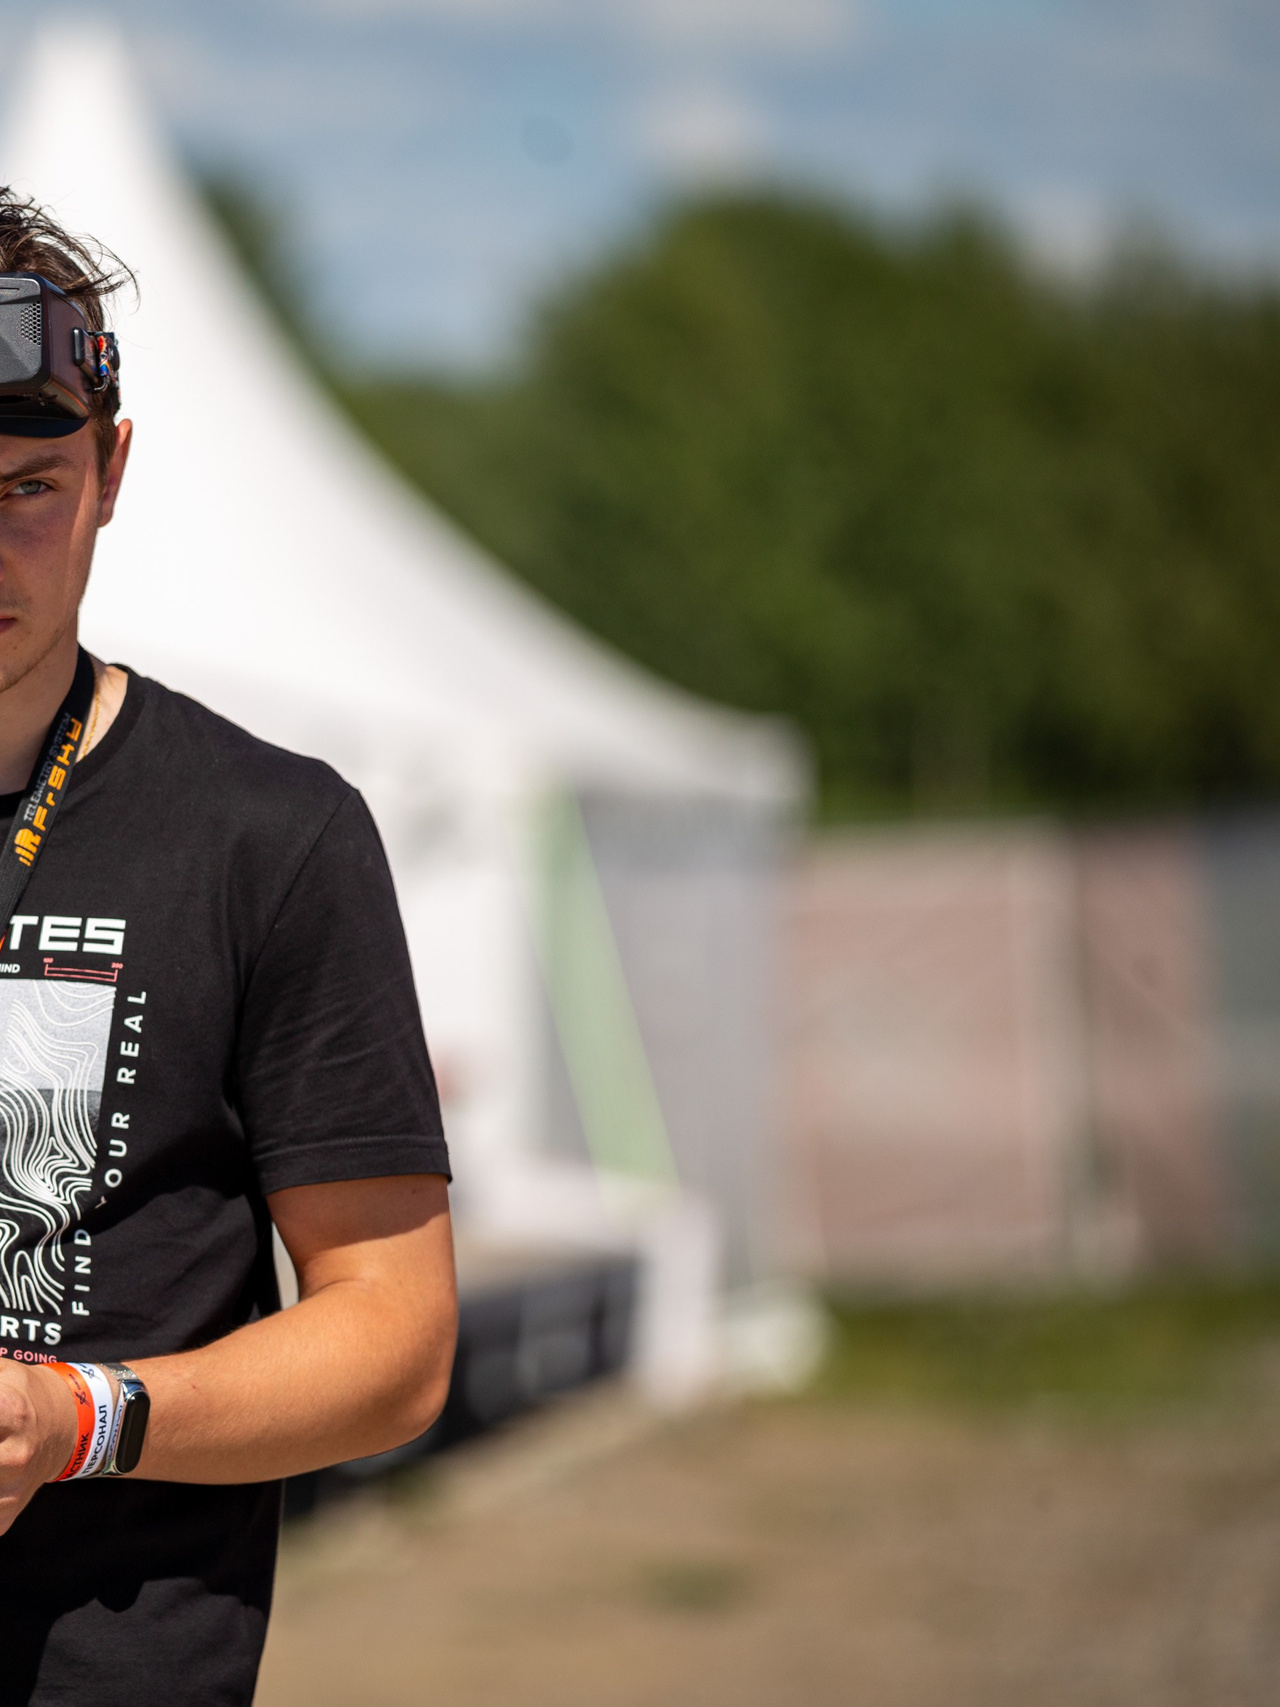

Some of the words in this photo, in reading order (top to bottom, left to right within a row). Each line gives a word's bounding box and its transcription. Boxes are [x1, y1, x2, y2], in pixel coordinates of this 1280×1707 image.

[23, 760, 54, 822] TELEMETRY
[71, 1229, 92, 1316] FIND
[116, 991, 147, 1085] REAL
[13, 1349, 58, 1363] GOING
[82, 1404, 108, 1474] ПЕРСОНАЛ
